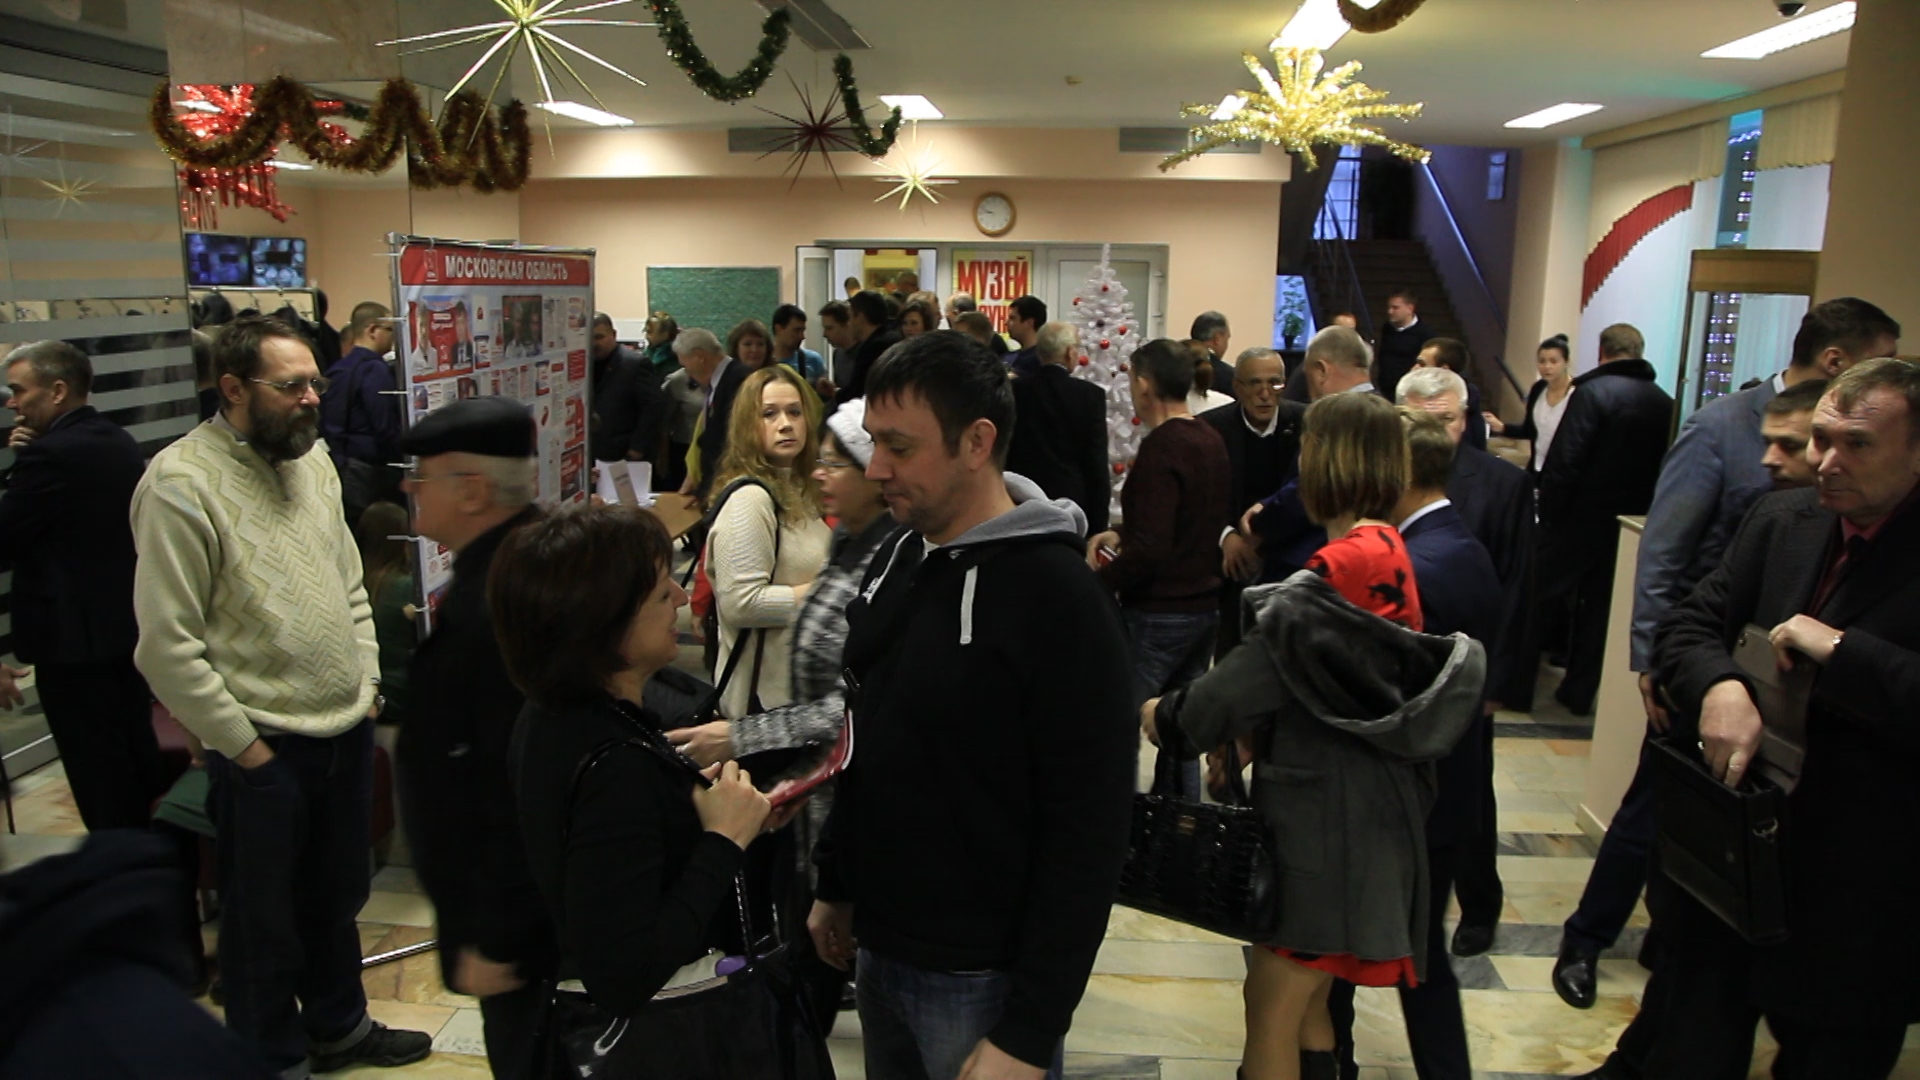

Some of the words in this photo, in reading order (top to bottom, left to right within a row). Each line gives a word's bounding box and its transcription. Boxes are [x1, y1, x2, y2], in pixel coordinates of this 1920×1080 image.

[445, 255, 523, 280] МОСКОВСКАЯ
[526, 261, 568, 280] ОБЛАСТЬ
[957, 255, 1028, 301] МУЗЕЙ
